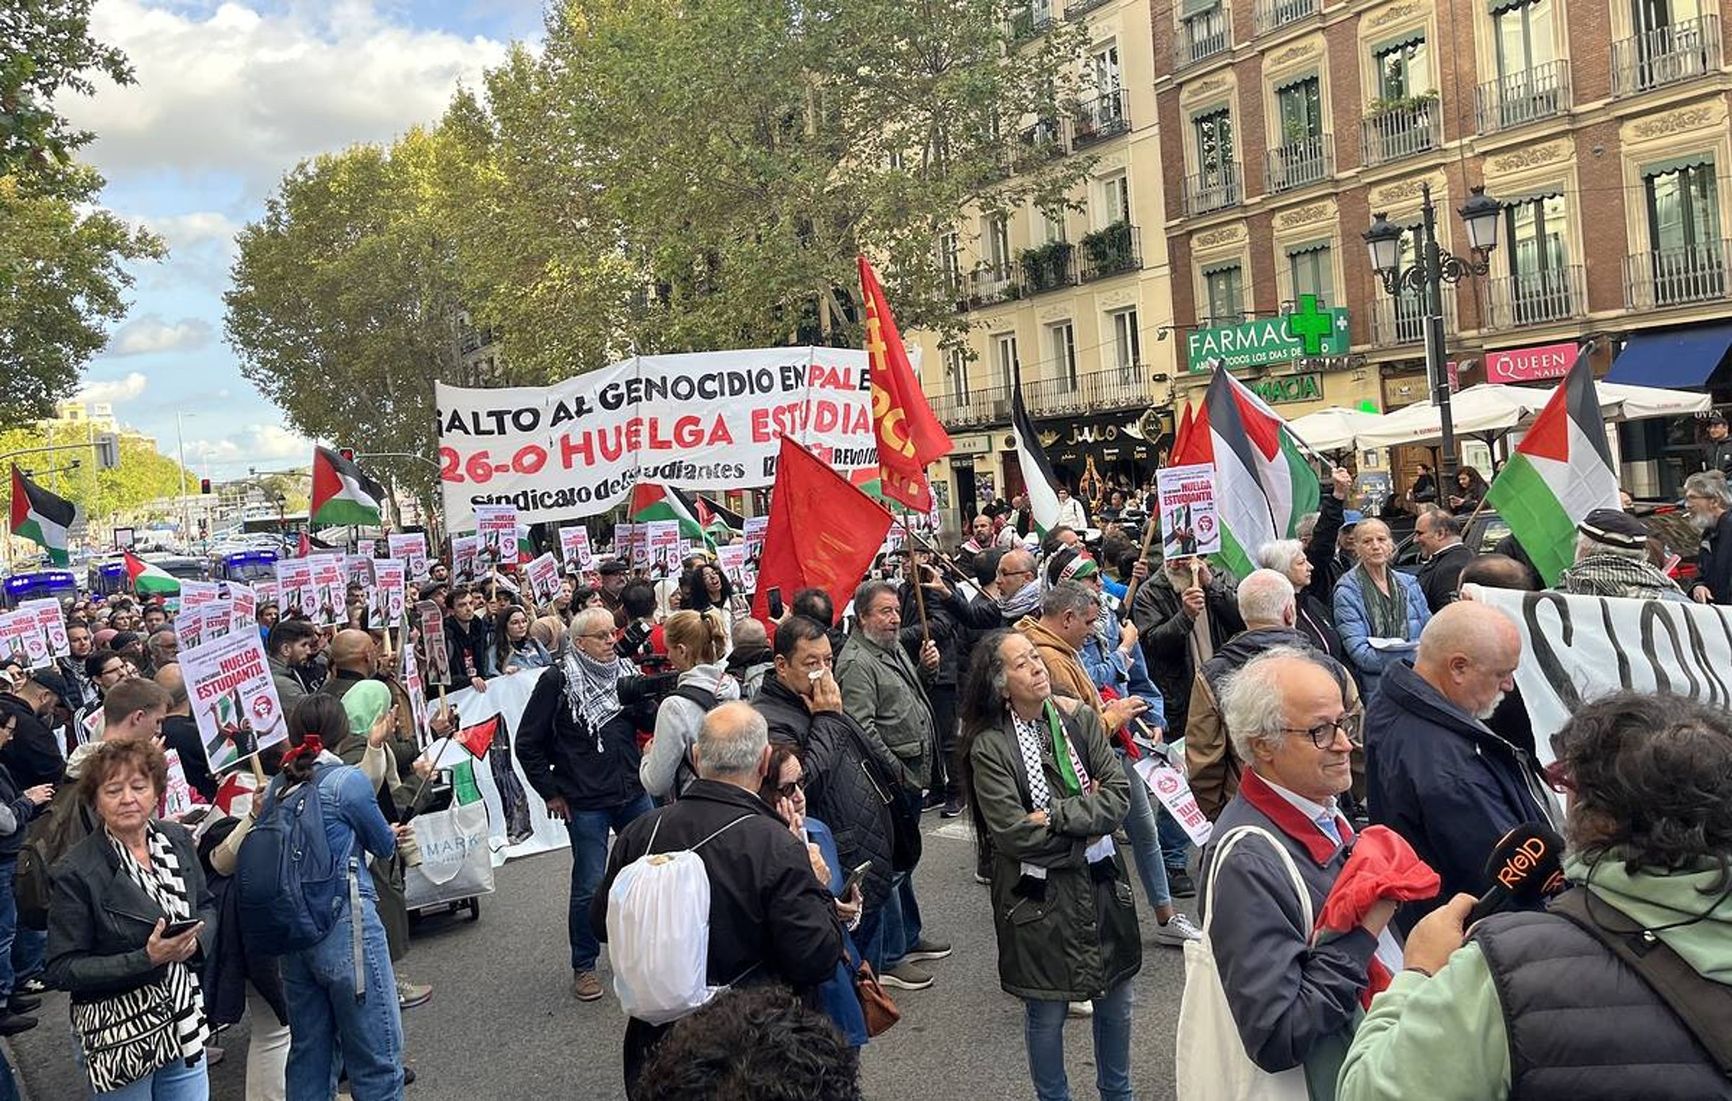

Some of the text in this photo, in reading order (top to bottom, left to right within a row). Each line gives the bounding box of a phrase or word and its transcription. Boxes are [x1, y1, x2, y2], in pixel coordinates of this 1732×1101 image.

[1190, 321, 1299, 357] FARMAC
[1497, 352, 1565, 379] QUEEN
[1535, 367, 1566, 378] NAILS
[550, 394, 594, 428] AL
[600, 367, 774, 411] GENOCIDIO
[780, 364, 806, 393] EN
[808, 364, 871, 391] PALE
[1254, 375, 1319, 399] MACIA
[560, 411, 734, 470] HUELGA
[751, 399, 874, 444] ESTUDIA
[1163, 490, 1213, 506] ESTUDIANTIL
[1181, 480, 1212, 493] HUELGA
[219, 647, 261, 675] HUELGA
[196, 661, 265, 700] ESTUDIANTIL
